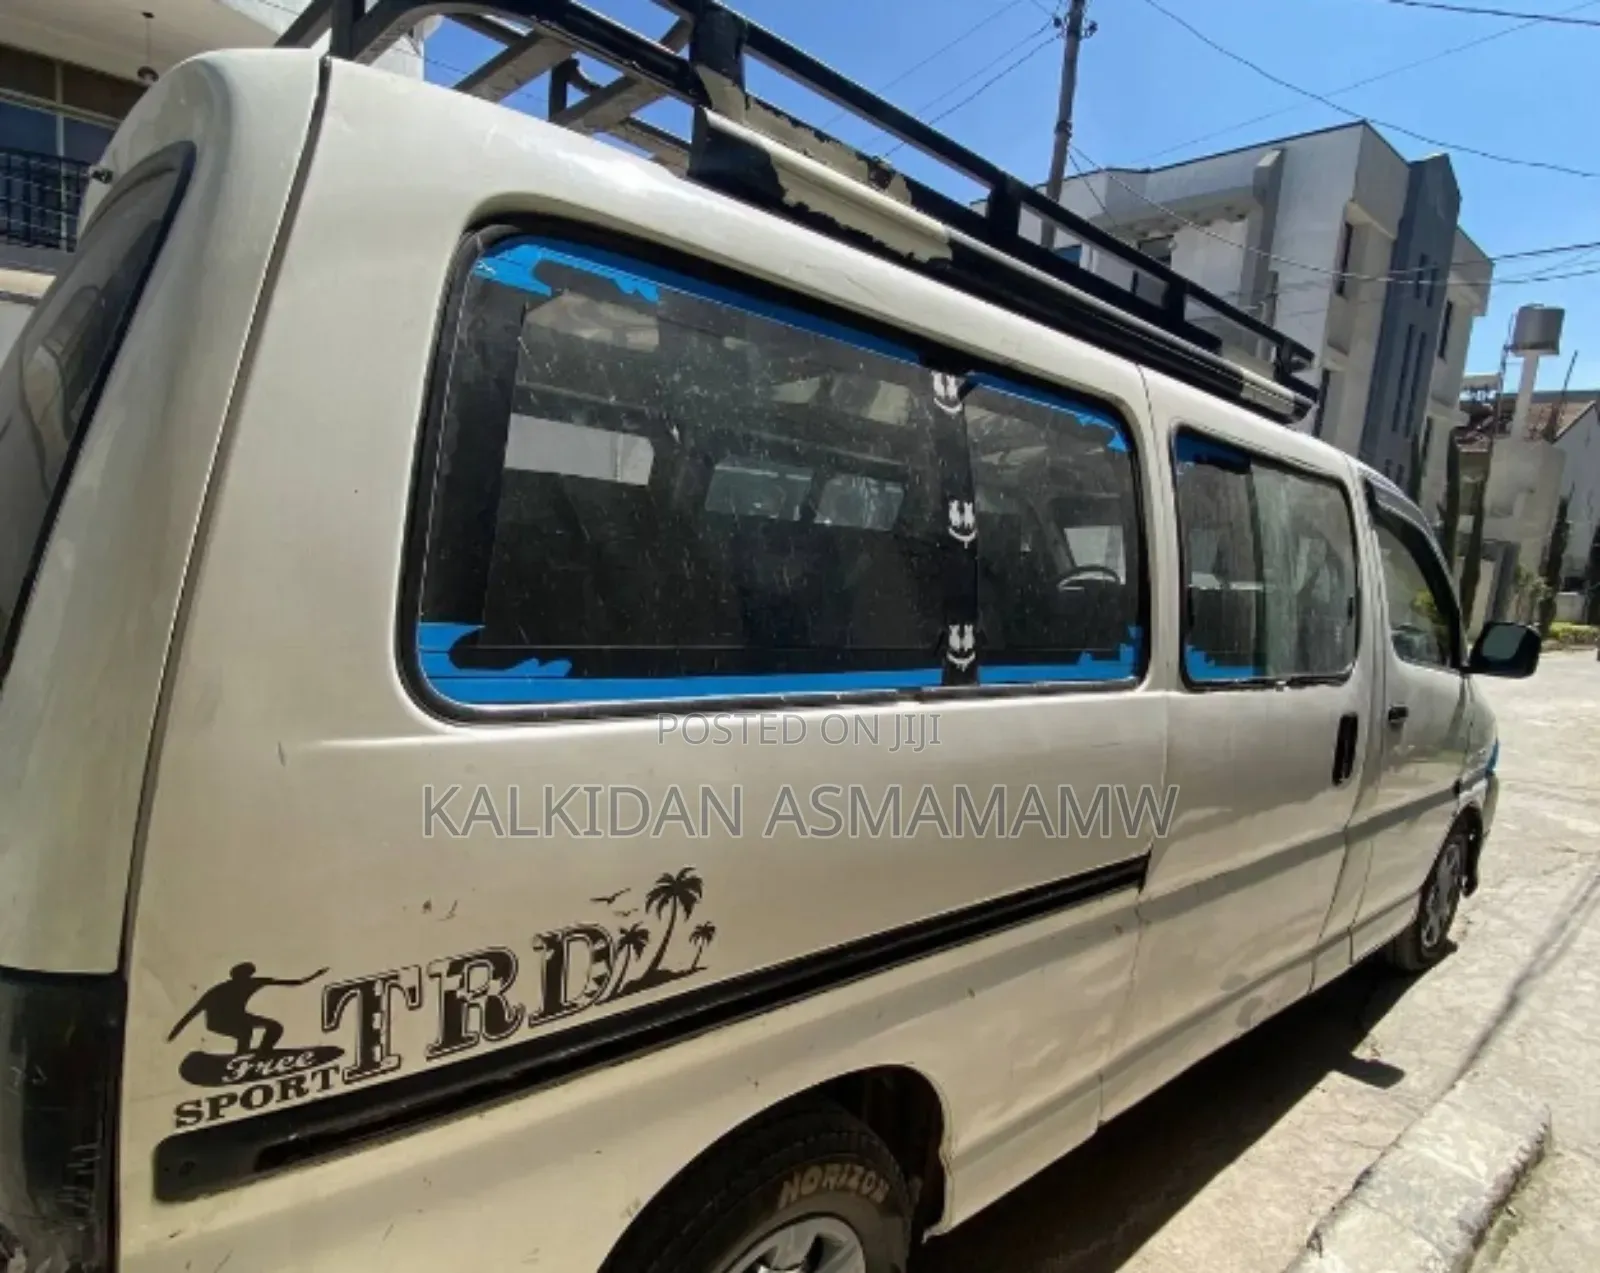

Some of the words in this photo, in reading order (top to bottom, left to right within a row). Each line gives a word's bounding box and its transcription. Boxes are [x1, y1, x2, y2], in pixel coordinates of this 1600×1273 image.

[320, 922, 616, 1084] TRD
[221, 1049, 319, 1083] Free
[174, 1067, 342, 1128] SPORT
[777, 1163, 890, 1209] HORIZON
